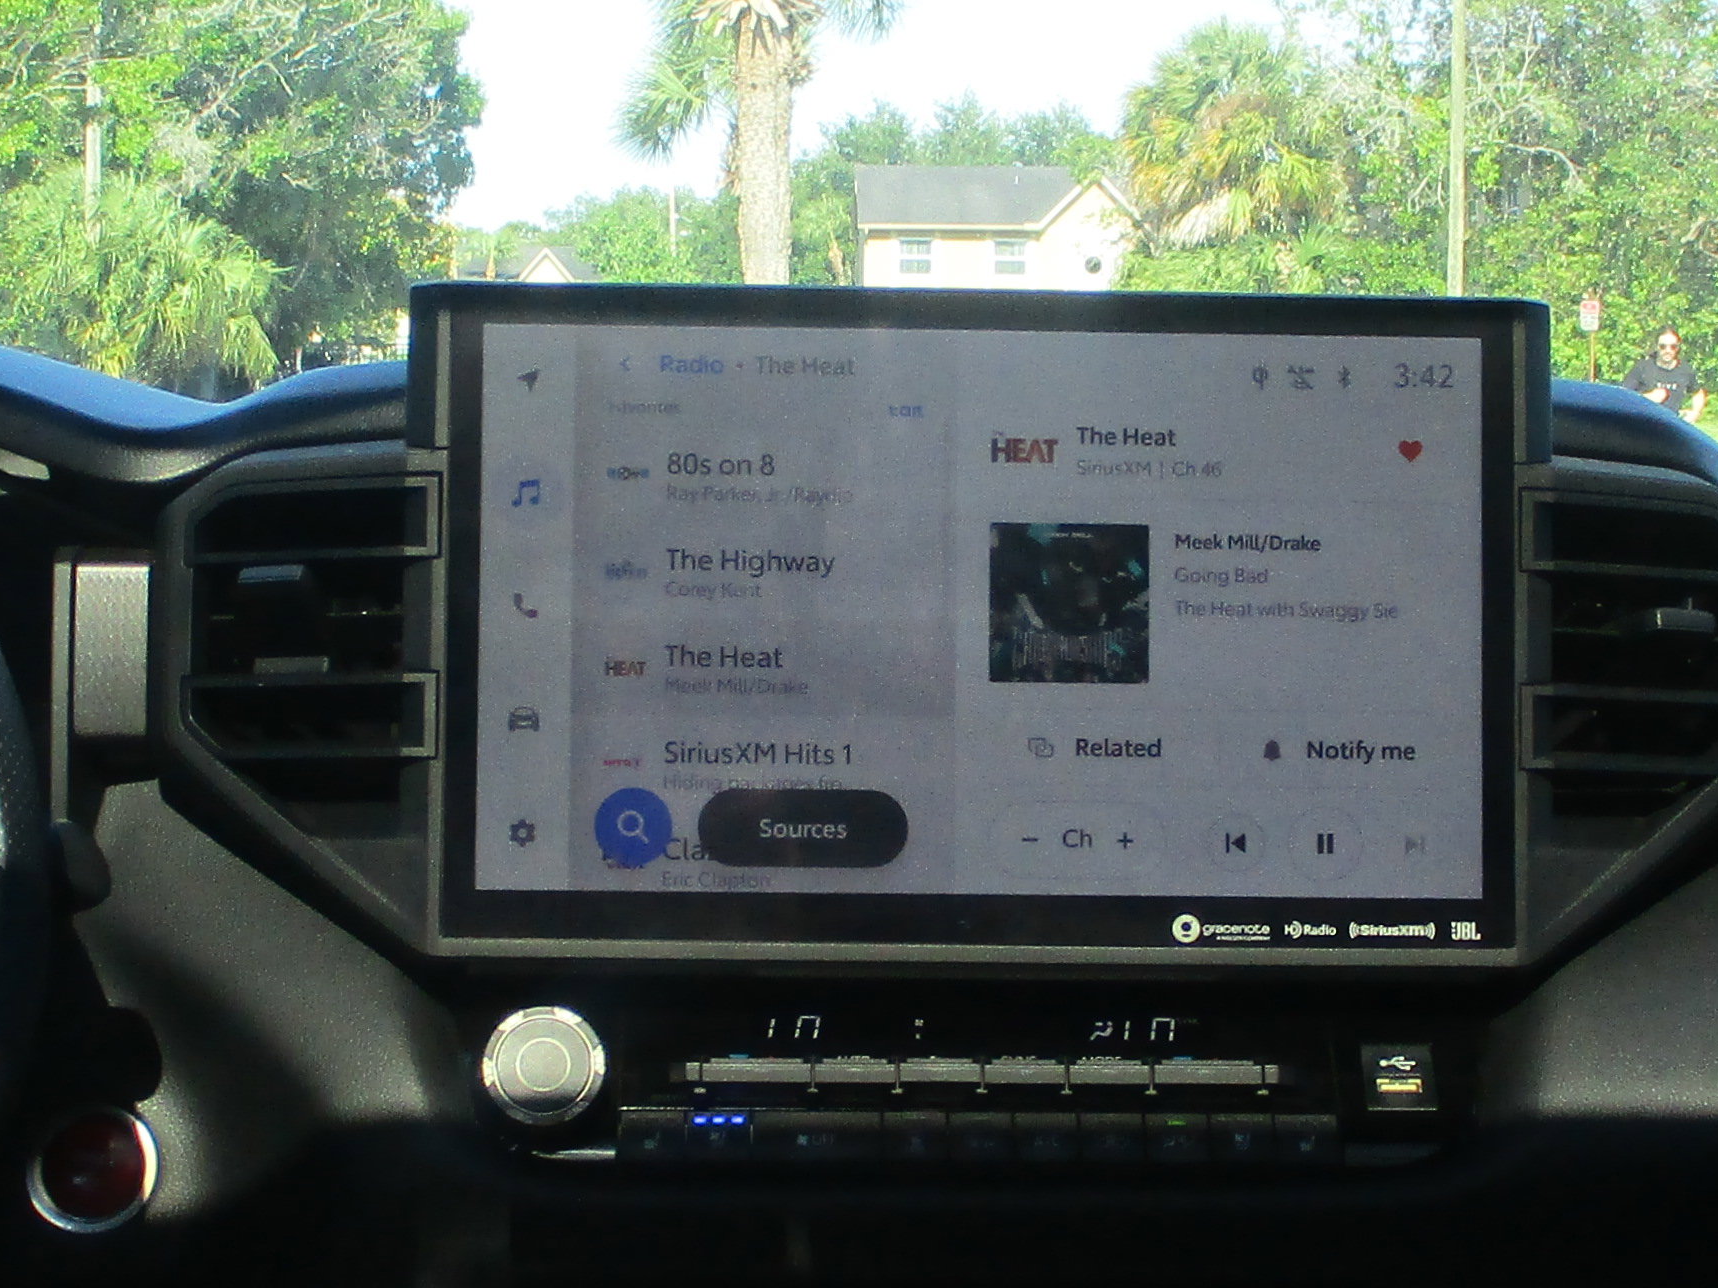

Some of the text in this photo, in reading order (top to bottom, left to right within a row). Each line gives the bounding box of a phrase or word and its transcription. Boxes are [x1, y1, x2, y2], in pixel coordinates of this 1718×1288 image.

[659, 354, 856, 377] Radio The Heat
[1394, 362, 1454, 389] 3:42
[1076, 426, 1177, 447] The Heat
[990, 437, 1059, 463] HEAT
[666, 452, 712, 476] 80s
[718, 457, 753, 476] on
[760, 453, 776, 477] 8
[1174, 533, 1322, 554] Meek Mill/Drake
[666, 548, 713, 572] The
[719, 549, 836, 579] Highway
[1174, 567, 1269, 587] Going Bad
[1175, 600, 1206, 617] The
[664, 645, 784, 669] The Heat
[663, 741, 777, 765] SiriusXM
[784, 743, 835, 766] Hits
[842, 743, 853, 766] 1
[1075, 737, 1162, 759] Related
[1306, 741, 1416, 766] Notify me
[759, 818, 849, 840] Sources
[1061, 828, 1093, 849] Ch
[662, 871, 771, 890] Eric Clapton
[1201, 923, 1271, 937] gracenote
[1303, 924, 1338, 937] Radio
[1451, 921, 1483, 941] JBL
